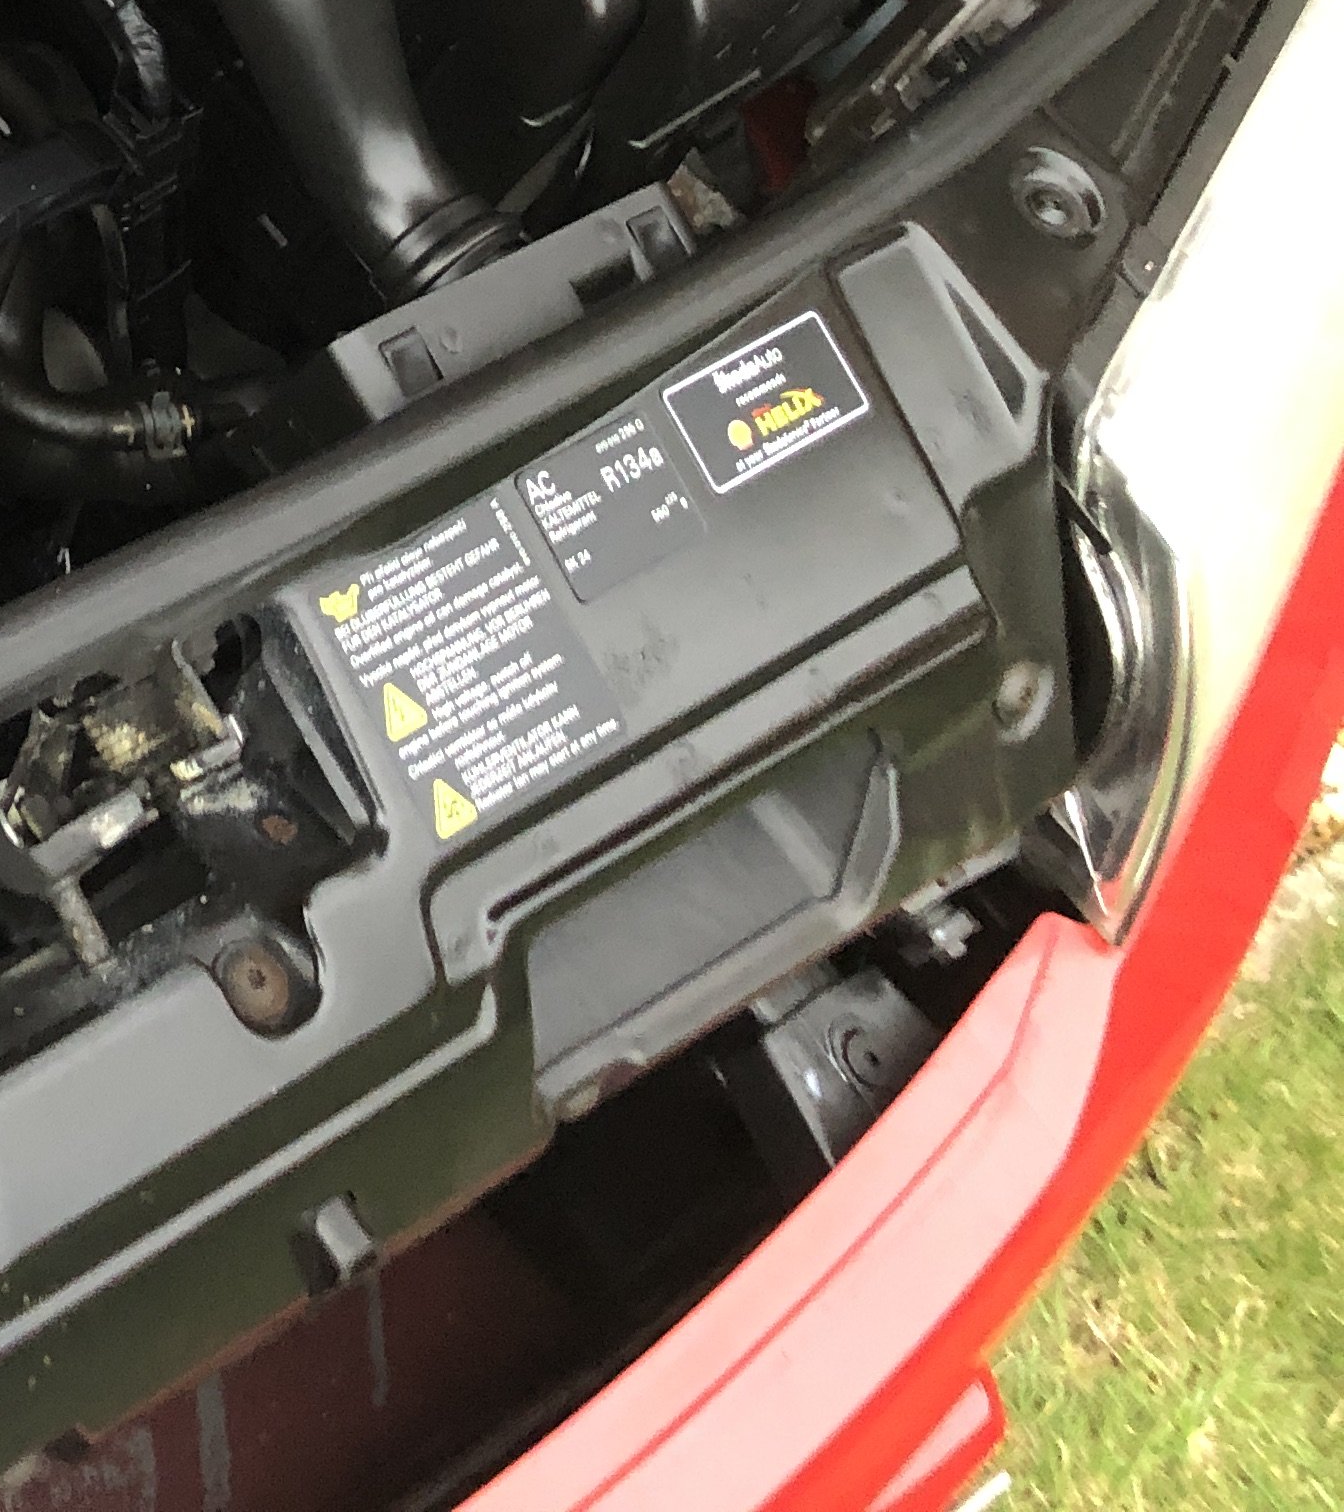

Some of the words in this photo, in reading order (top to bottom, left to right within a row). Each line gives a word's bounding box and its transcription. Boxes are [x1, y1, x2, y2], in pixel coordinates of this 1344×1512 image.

[754, 387, 822, 436] HELIX
[525, 470, 556, 505] AC
[599, 446, 663, 492] R134a
[424, 556, 464, 589] BESTEHT
[464, 537, 499, 567] GEFAHR
[435, 602, 453, 620] can
[452, 582, 489, 609] damage
[360, 620, 382, 644] DEN
[497, 614, 533, 644] MOTOR
